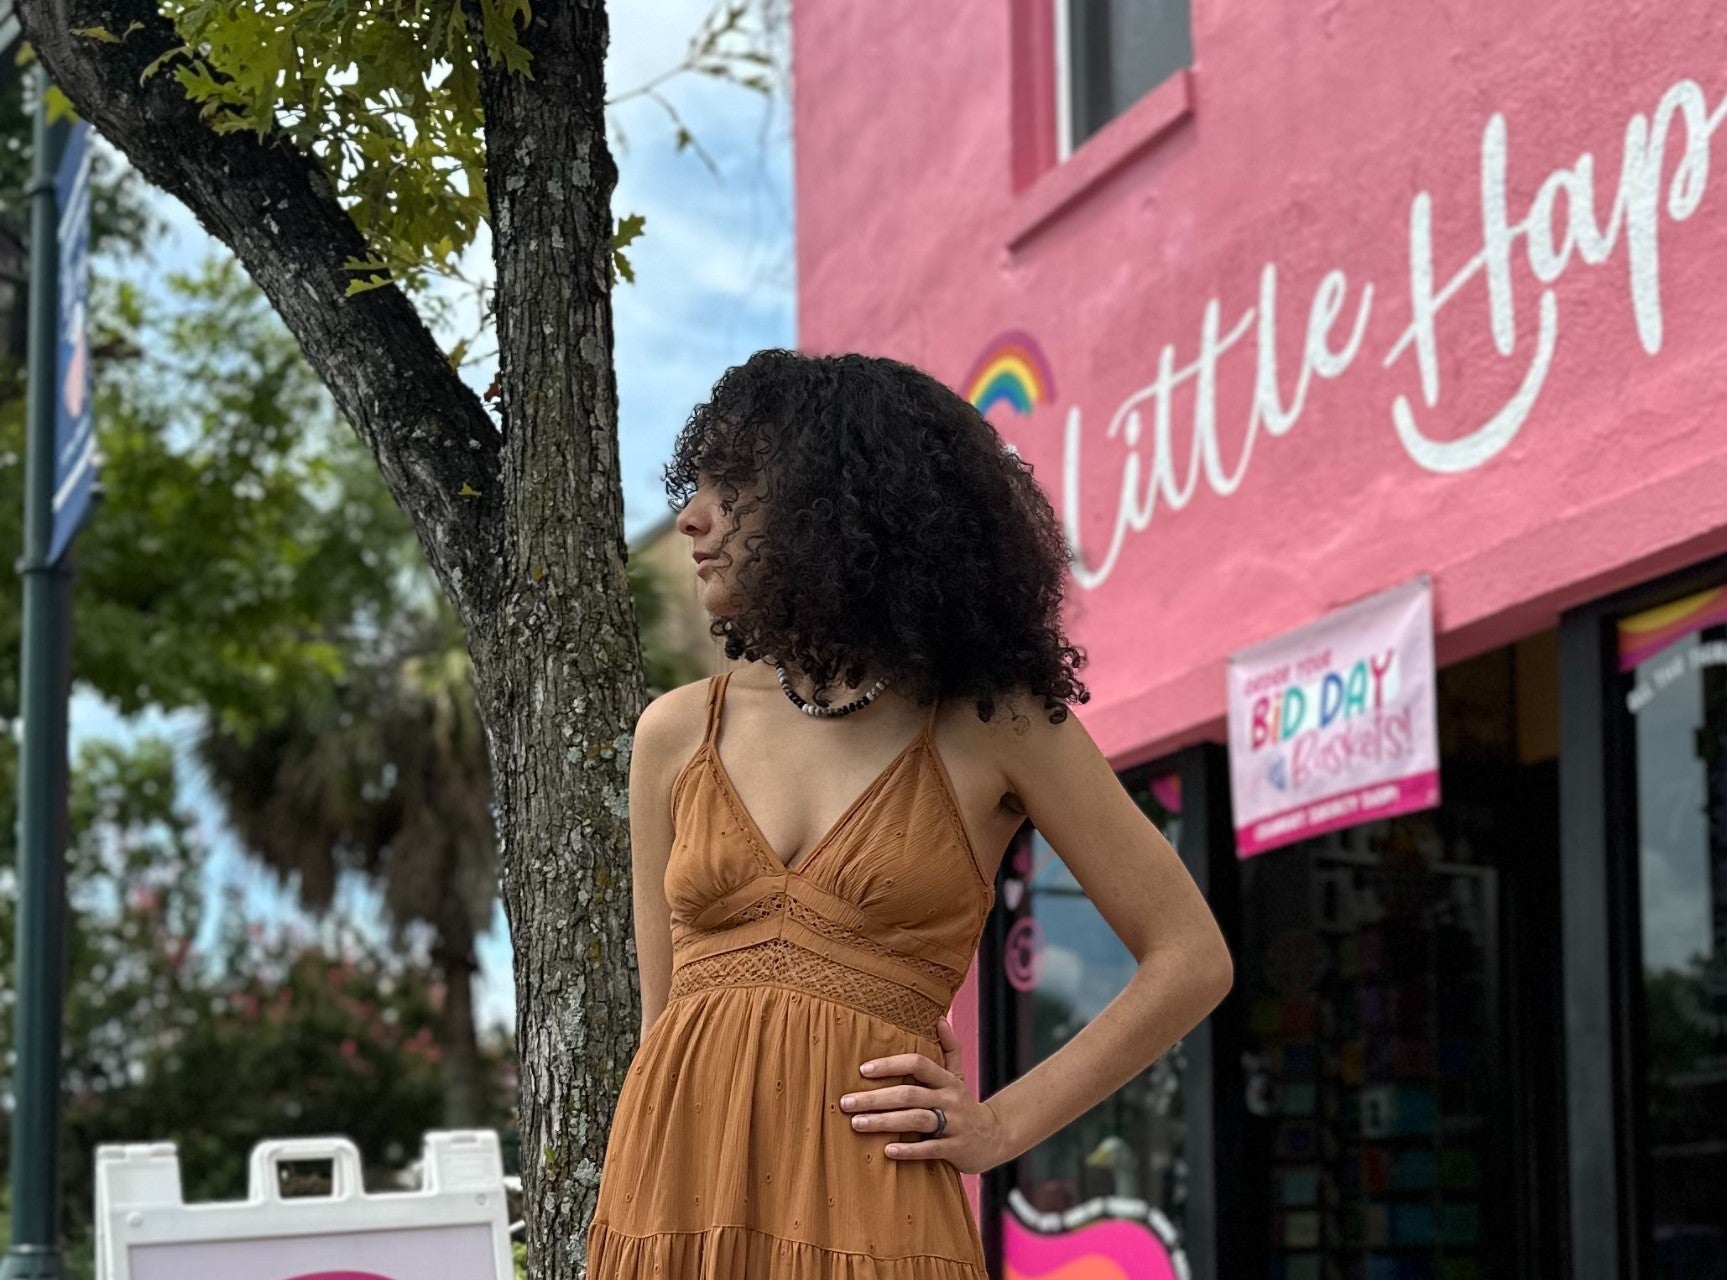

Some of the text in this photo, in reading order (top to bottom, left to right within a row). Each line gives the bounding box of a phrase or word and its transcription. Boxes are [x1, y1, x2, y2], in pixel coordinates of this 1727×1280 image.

[1063, 79, 1727, 589] Little Hap
[1319, 647, 1394, 729] DAY
